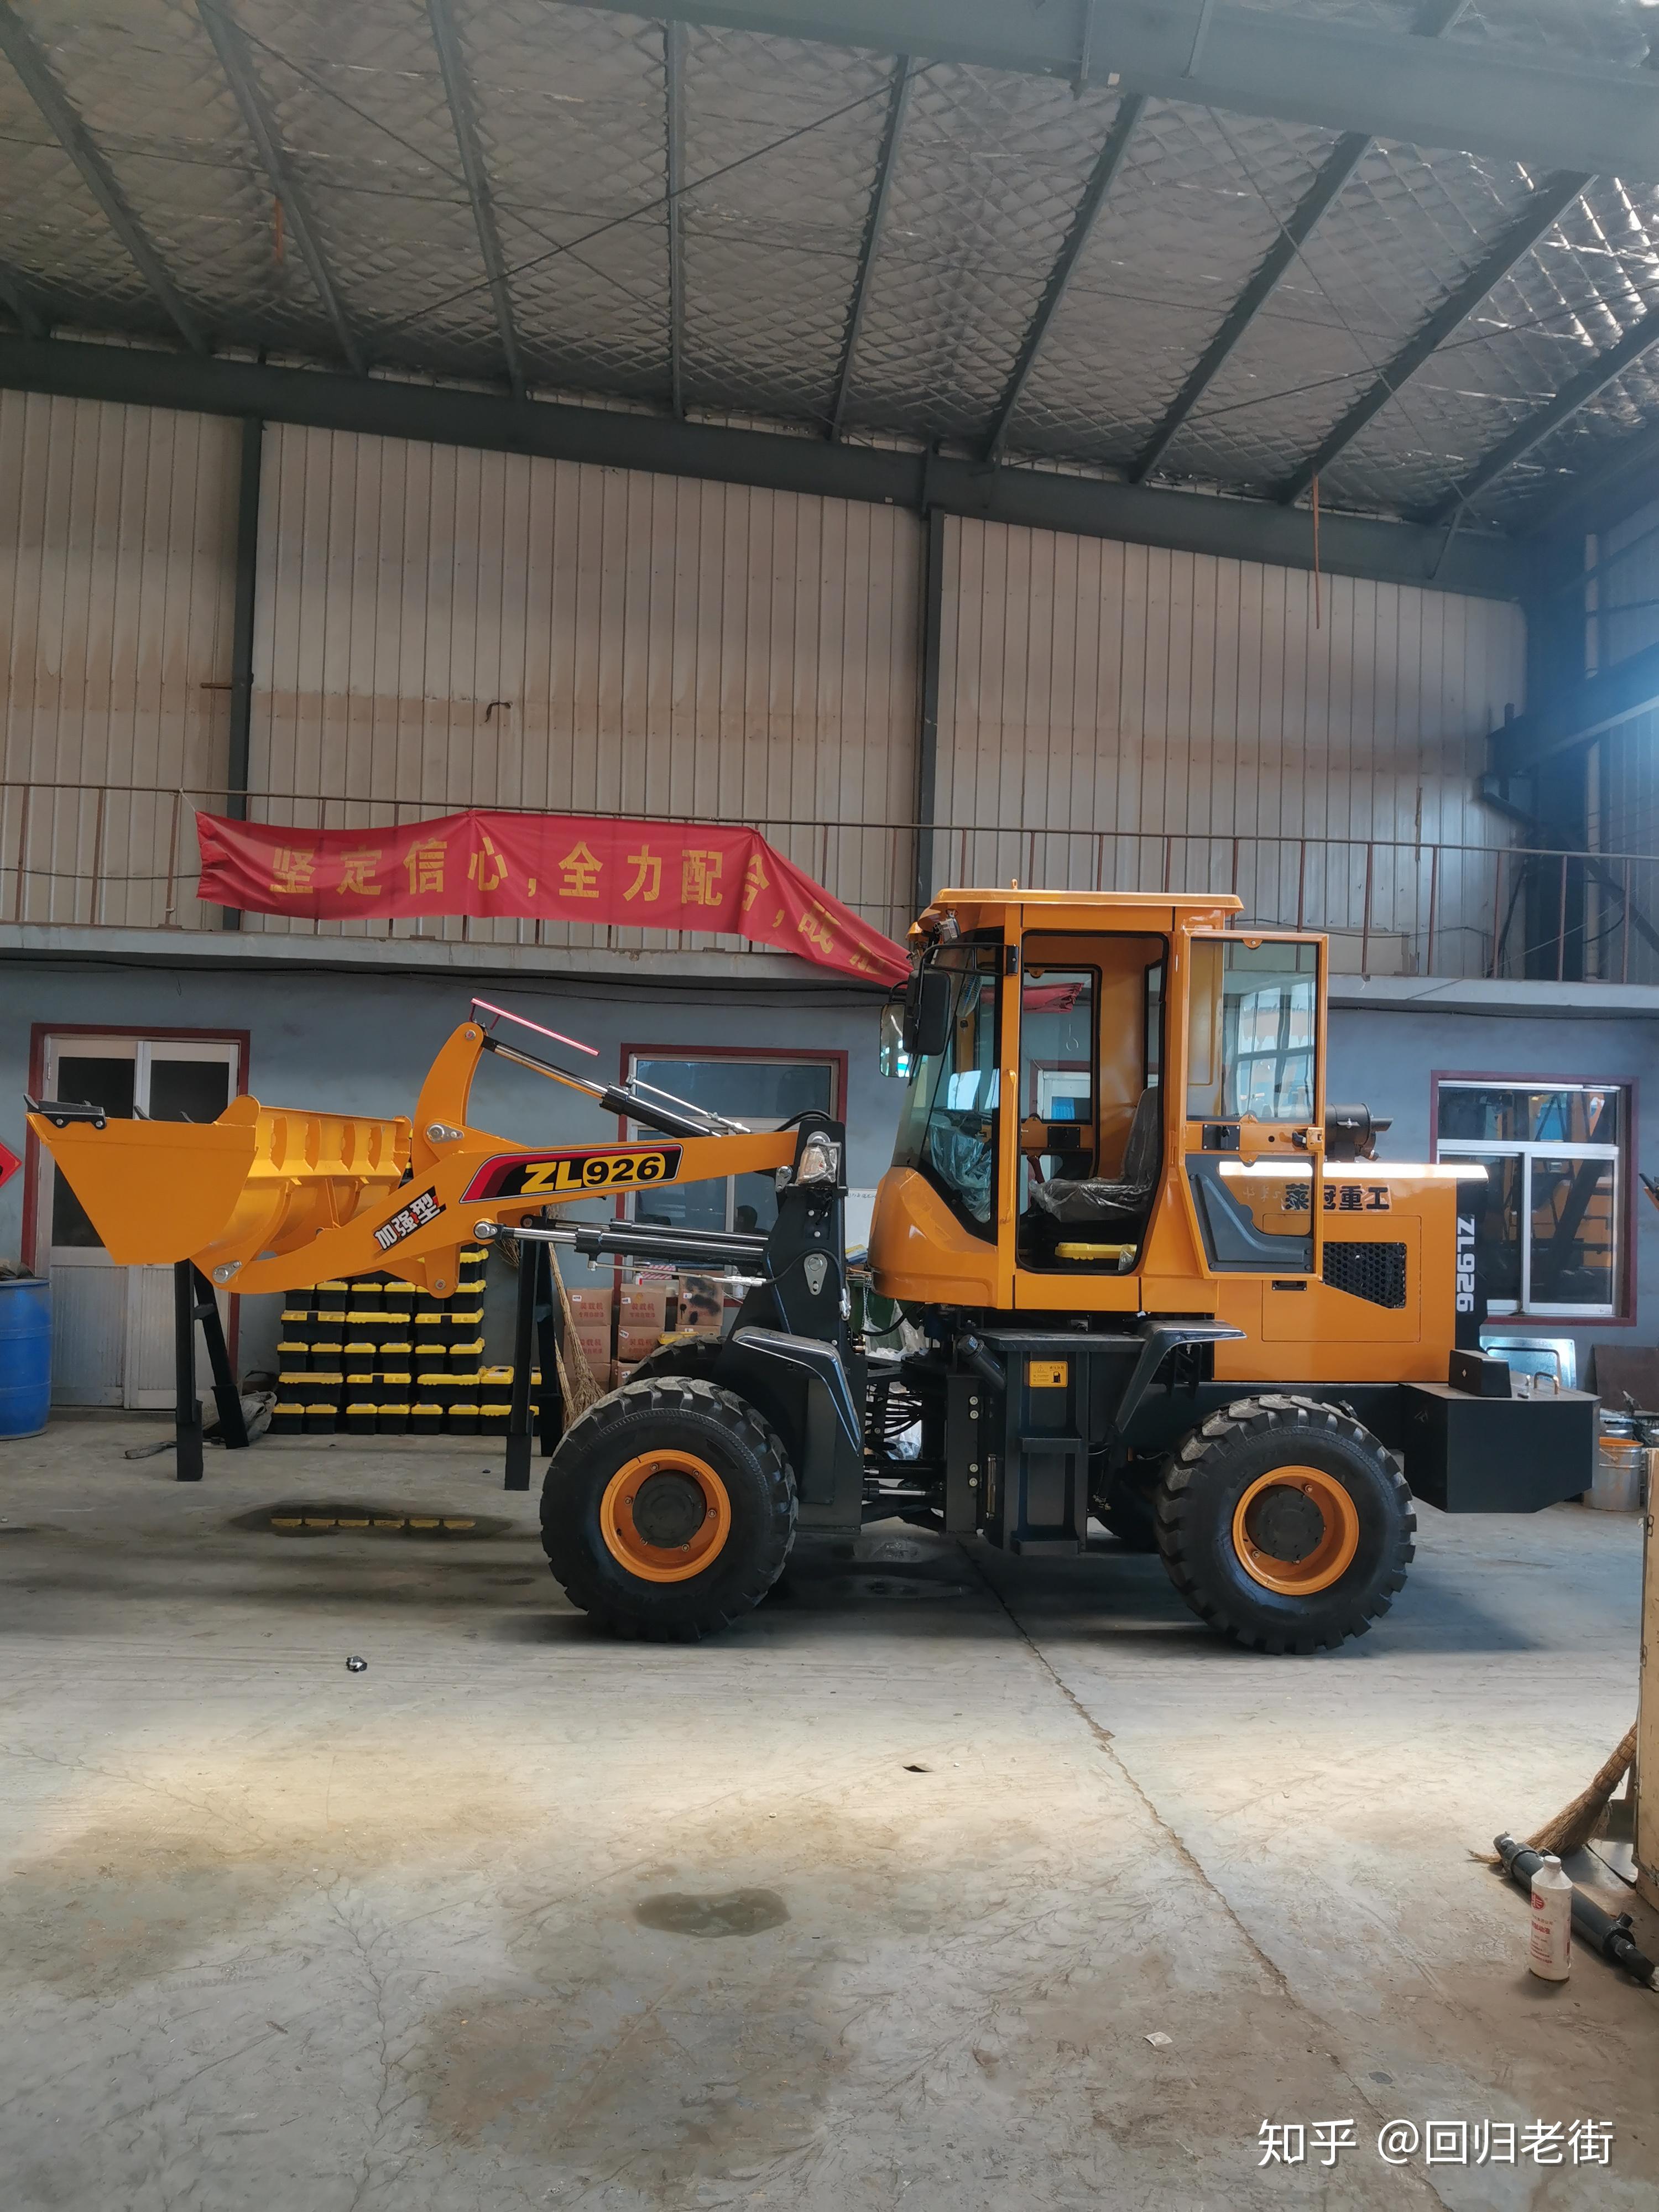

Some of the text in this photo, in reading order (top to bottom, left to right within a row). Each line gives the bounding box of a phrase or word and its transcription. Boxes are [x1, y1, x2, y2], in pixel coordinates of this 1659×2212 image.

[520, 1156, 661, 1193] ZL926
[374, 1193, 440, 1249] 加强型
[1457, 1217, 1475, 1312] ZL926
